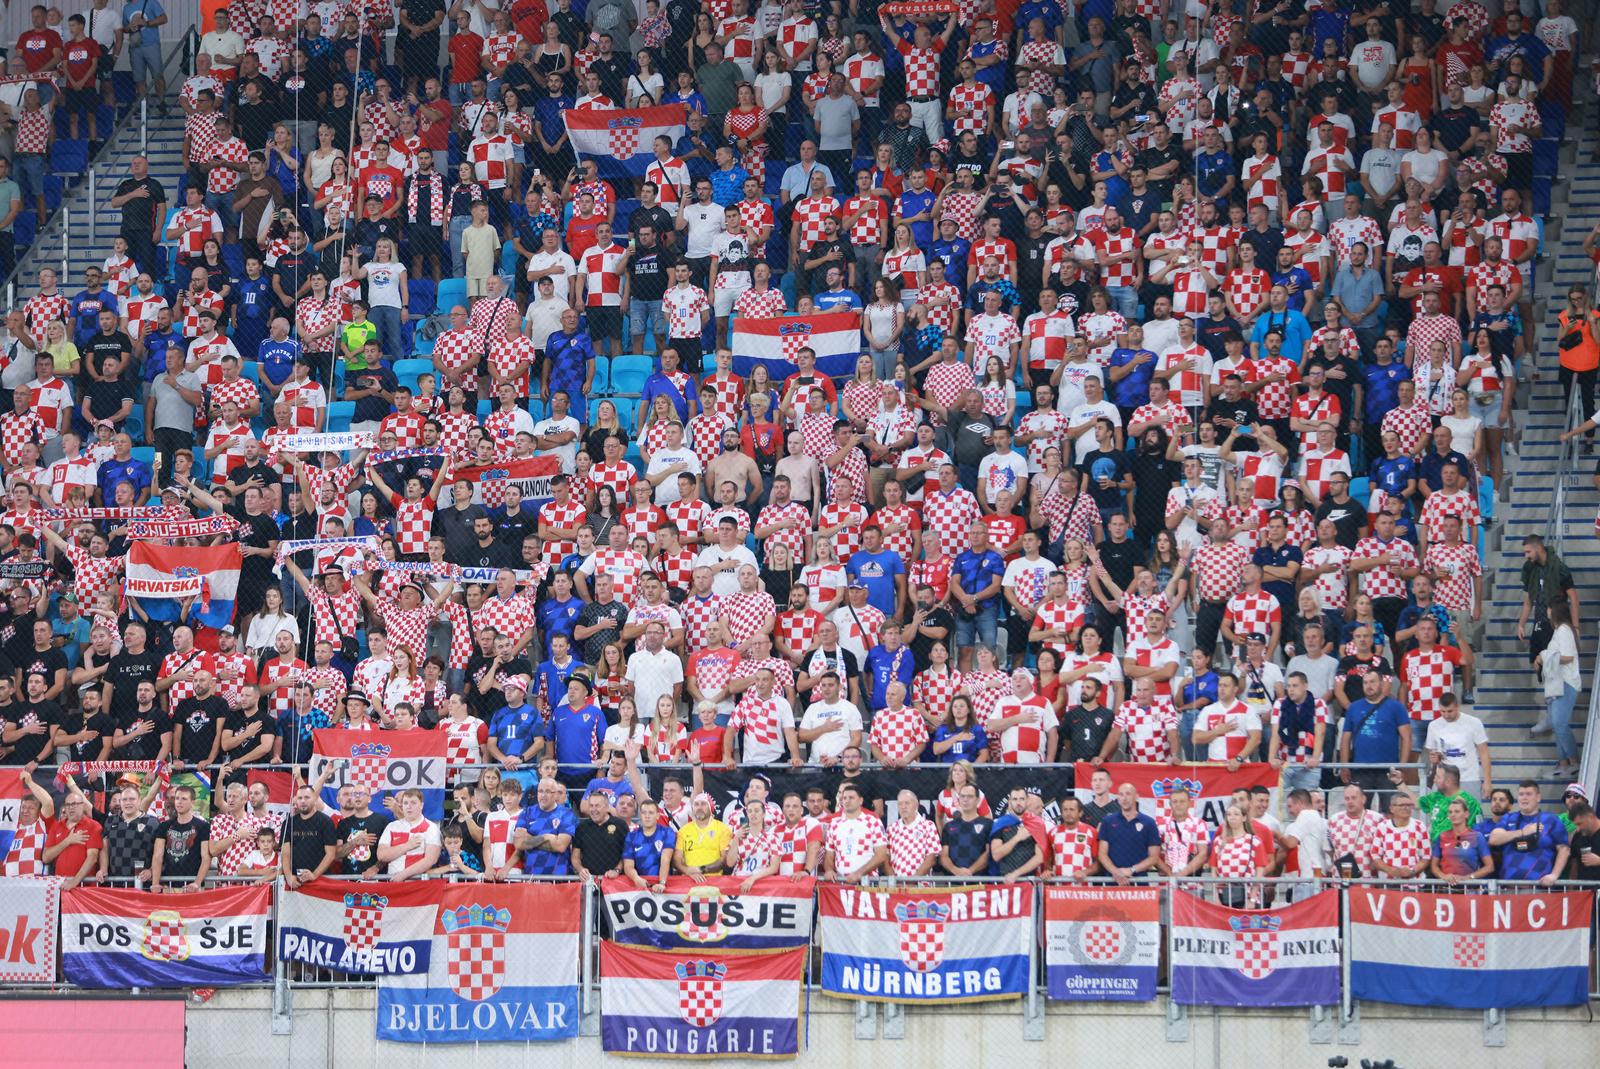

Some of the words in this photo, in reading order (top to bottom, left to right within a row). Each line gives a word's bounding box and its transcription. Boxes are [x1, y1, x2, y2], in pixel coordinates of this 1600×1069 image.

[889, 5, 950, 15] Hrvatska
[246, 293, 256, 304] 10
[679, 307, 686, 317] 10
[985, 335, 996, 346] 20
[380, 560, 432, 571] CROATIA
[128, 579, 199, 592] HRVATSKA
[881, 672, 887, 683] 5
[507, 725, 516, 739] 11
[953, 742, 963, 753] 10
[91, 760, 149, 769] HRVATSKA
[387, 759, 434, 786] OK
[684, 840, 694, 852] 12
[745, 857, 757, 872] 10
[1049, 889, 1104, 900] HRVATSKI
[840, 888, 890, 918] VAT
[951, 887, 1022, 920] RENI
[1365, 892, 1570, 928] VOĐINCI
[610, 895, 796, 930] POSUŠJE
[79, 923, 131, 947] POS
[200, 920, 253, 949] ŠJE
[284, 933, 416, 973] PAKLAREVO
[1173, 938, 1230, 956] PLETE
[1283, 938, 1340, 956] RNICA
[842, 963, 1002, 996] NÜRNBERG
[1065, 974, 1139, 990] GÖPPINGEN
[387, 1001, 568, 1031] BJELOVAR
[627, 1026, 774, 1054] POUGARJE
